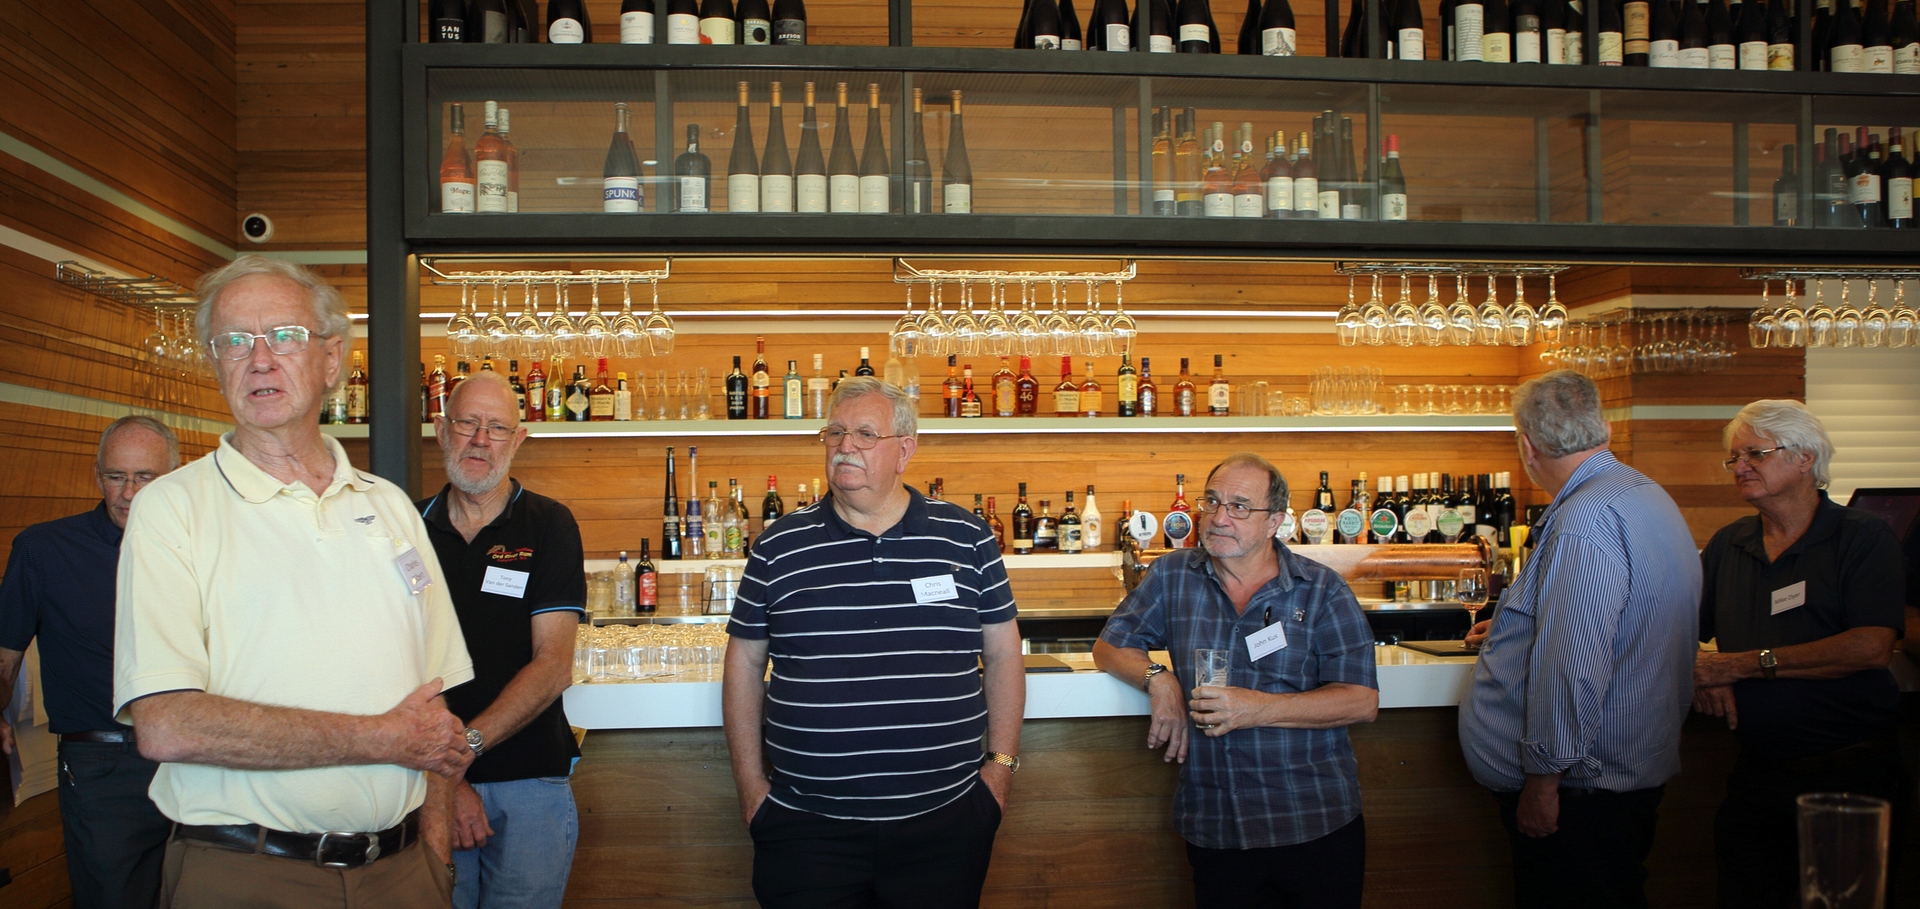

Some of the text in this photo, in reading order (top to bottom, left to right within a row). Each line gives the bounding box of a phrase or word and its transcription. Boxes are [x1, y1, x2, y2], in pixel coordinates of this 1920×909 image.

[441, 25, 460, 33] SAN
[441, 32, 460, 40] TUS
[605, 189, 636, 199] SPUNK
[1019, 391, 1034, 402] 46
[1774, 592, 1801, 605] Mike Dyer
[1254, 634, 1279, 649] John Kus
